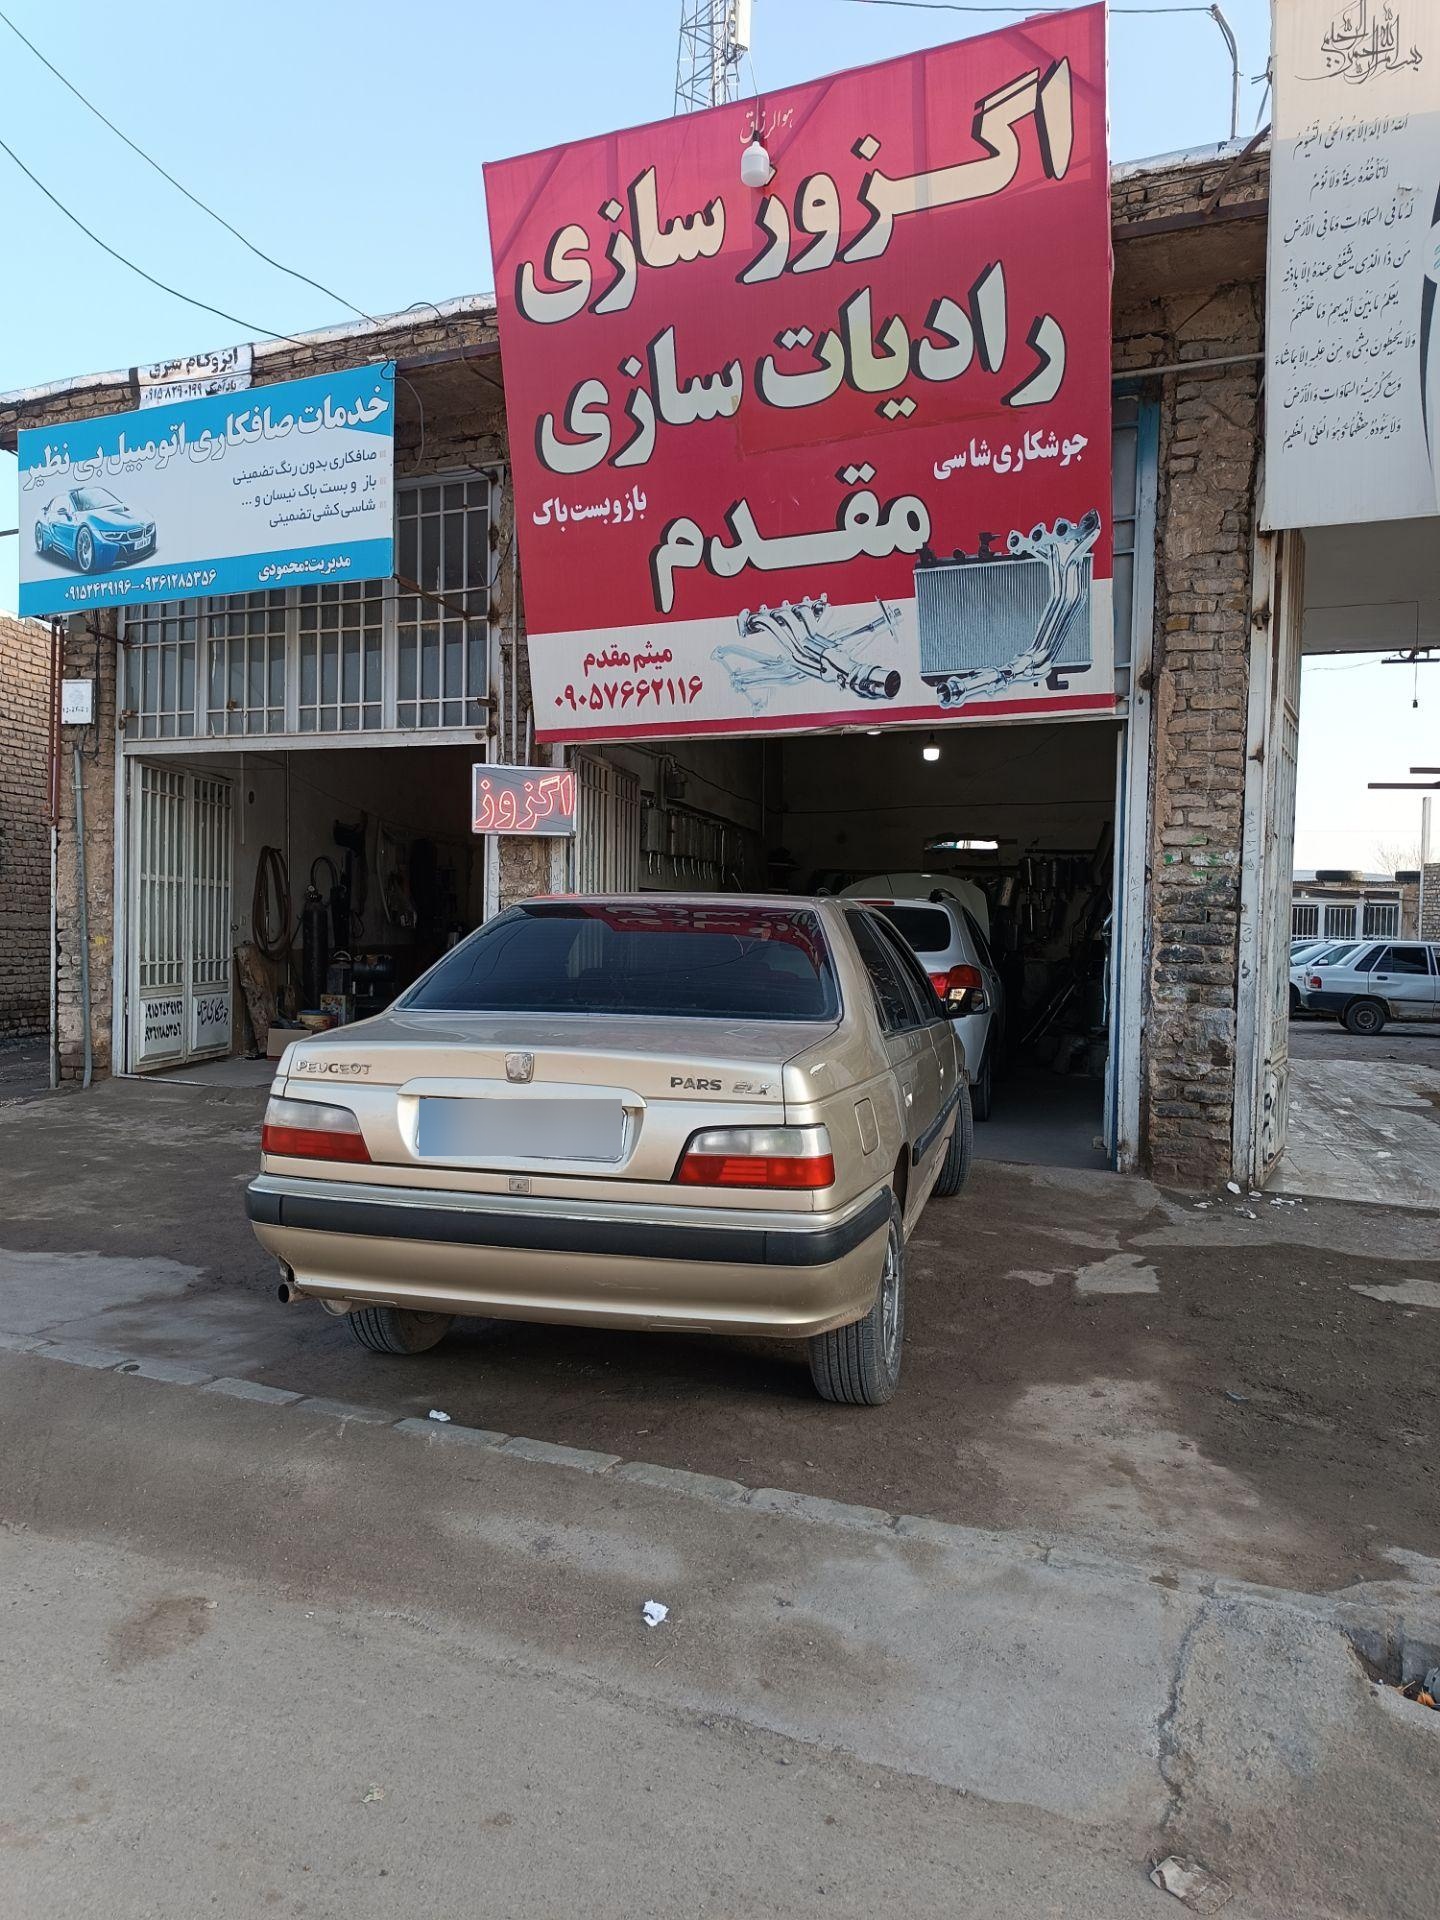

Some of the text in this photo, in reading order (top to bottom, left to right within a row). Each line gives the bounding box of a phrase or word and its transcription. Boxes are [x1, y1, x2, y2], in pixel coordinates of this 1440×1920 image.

[514, 165, 727, 325] سازی
[534, 260, 1067, 475] رادیات سازی
[23, 385, 390, 492] خدمات صافکاری اتومبیل بی نظیر
[933, 429, 1088, 480] جوشکاری شاسی
[232, 448, 377, 485] صافکاری بدون رنگ تضمینی
[363, 474, 377, 492] باز
[254, 494, 261, 507] و
[263, 488, 296, 506] نیسان
[298, 484, 318, 499] باک
[320, 482, 348, 495] بست
[350, 480, 357, 493] و
[269, 498, 376, 528] شاسی کشی تضمینی
[532, 497, 569, 532] باک
[650, 463, 931, 614] مقدم
[583, 641, 673, 677] میثم مقدم
[554, 675, 703, 711] ۰۹۰۵۷۶۶۲۱۱۶
[474, 774, 573, 830] اگزوز
[296, 1060, 372, 1074] PEUGEOT
[670, 1076, 722, 1091] PARS
